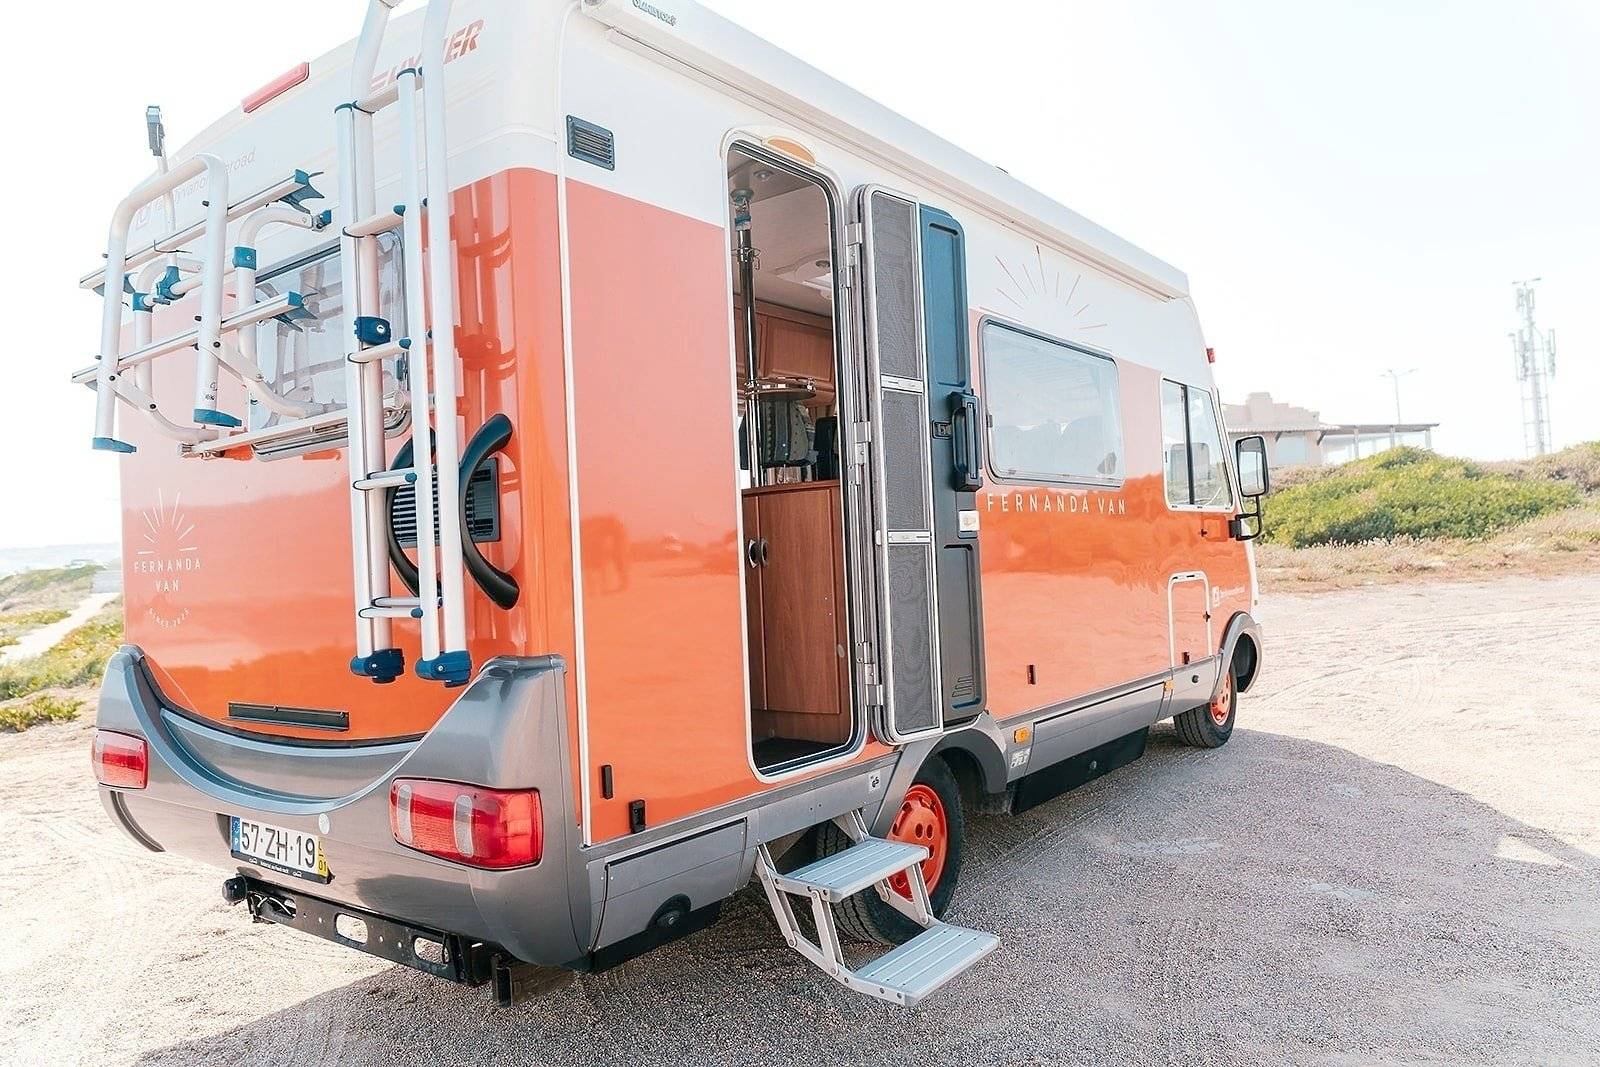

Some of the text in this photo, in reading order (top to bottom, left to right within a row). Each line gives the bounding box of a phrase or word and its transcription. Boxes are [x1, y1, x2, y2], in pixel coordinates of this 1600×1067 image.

[987, 493, 1126, 515] FERNANDA VAN
[133, 558, 201, 573] FERNANDA
[156, 579, 180, 592] VAN
